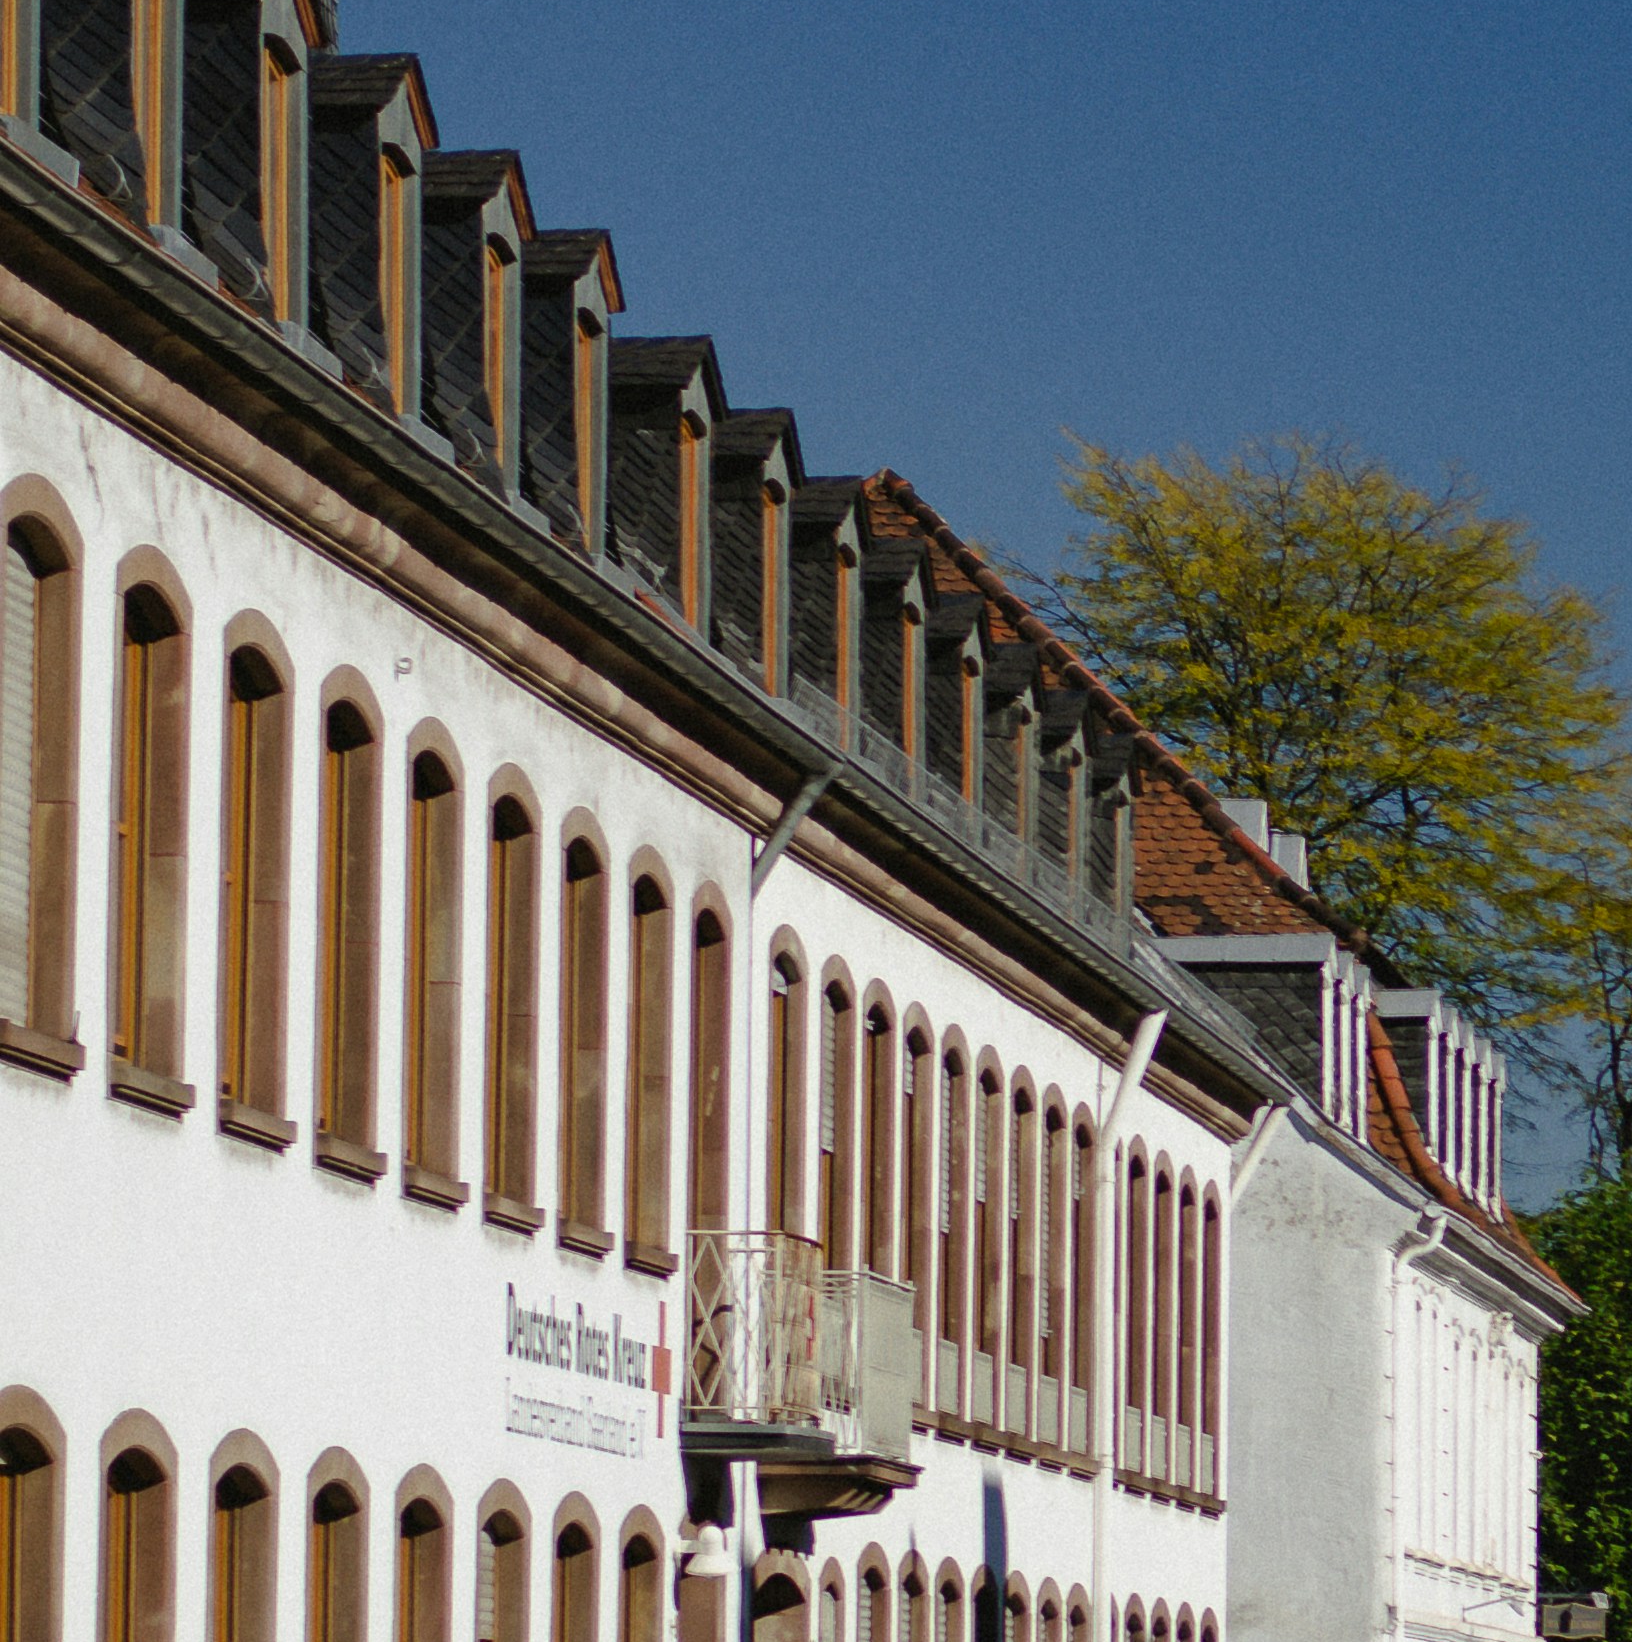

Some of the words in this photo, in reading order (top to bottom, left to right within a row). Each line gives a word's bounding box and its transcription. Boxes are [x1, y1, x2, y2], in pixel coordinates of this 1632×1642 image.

[506, 1282, 572, 1372] Deutsches
[575, 1302, 609, 1381] Rotes
[612, 1313, 646, 1389] Kreuz
